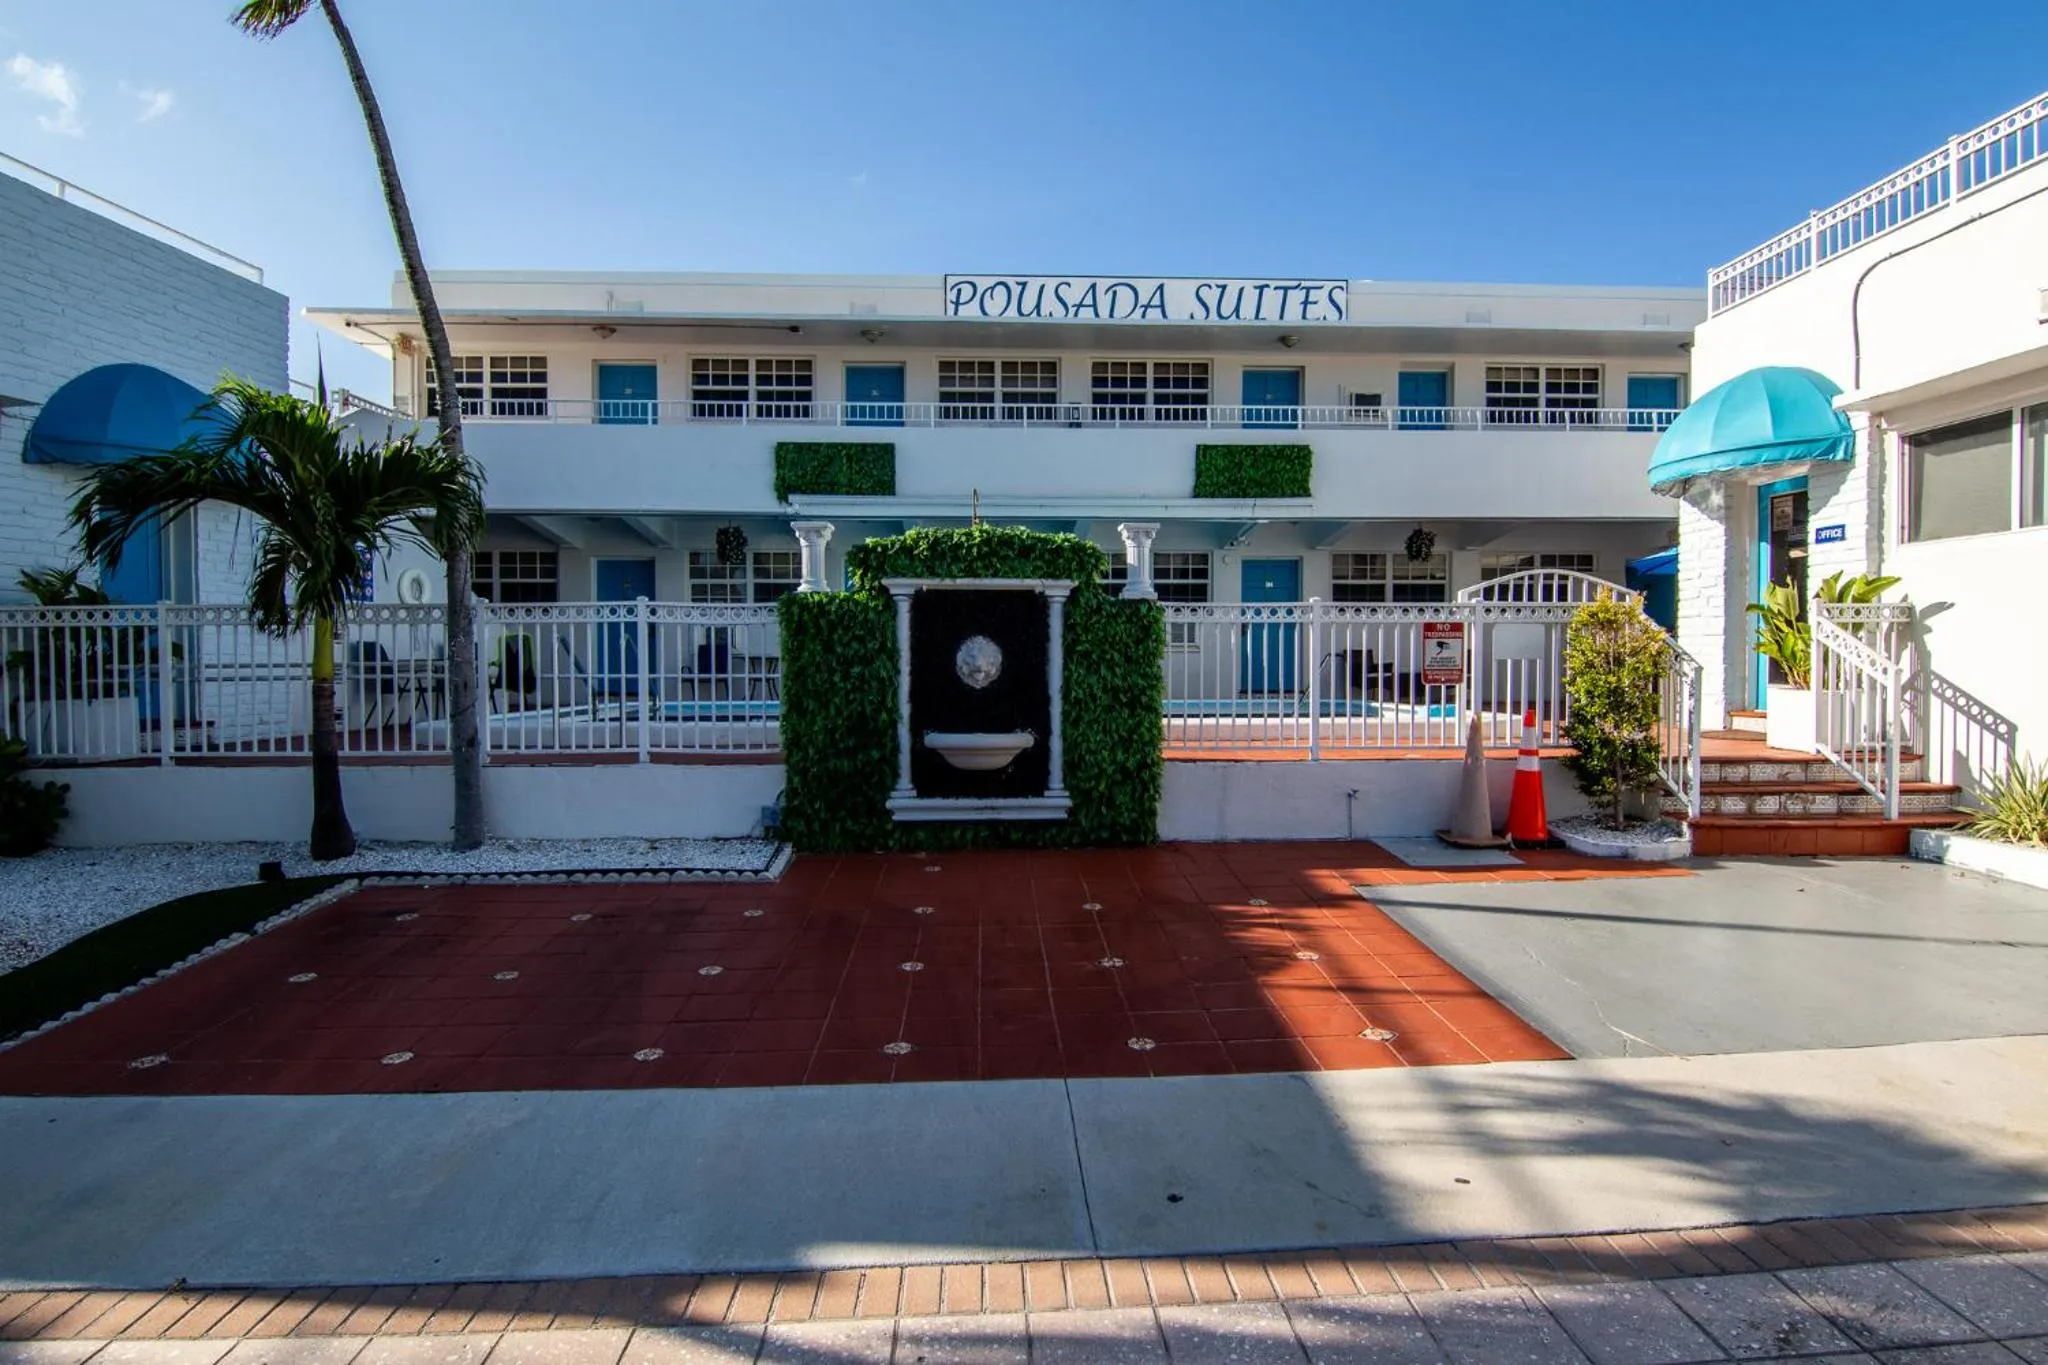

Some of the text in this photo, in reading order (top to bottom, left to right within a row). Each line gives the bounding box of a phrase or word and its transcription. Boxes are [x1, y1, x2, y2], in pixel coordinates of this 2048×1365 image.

[949, 280, 1345, 321] POUSADA SUITES
[1817, 527, 1843, 540] OFFICE
[1437, 623, 1451, 631] NO
